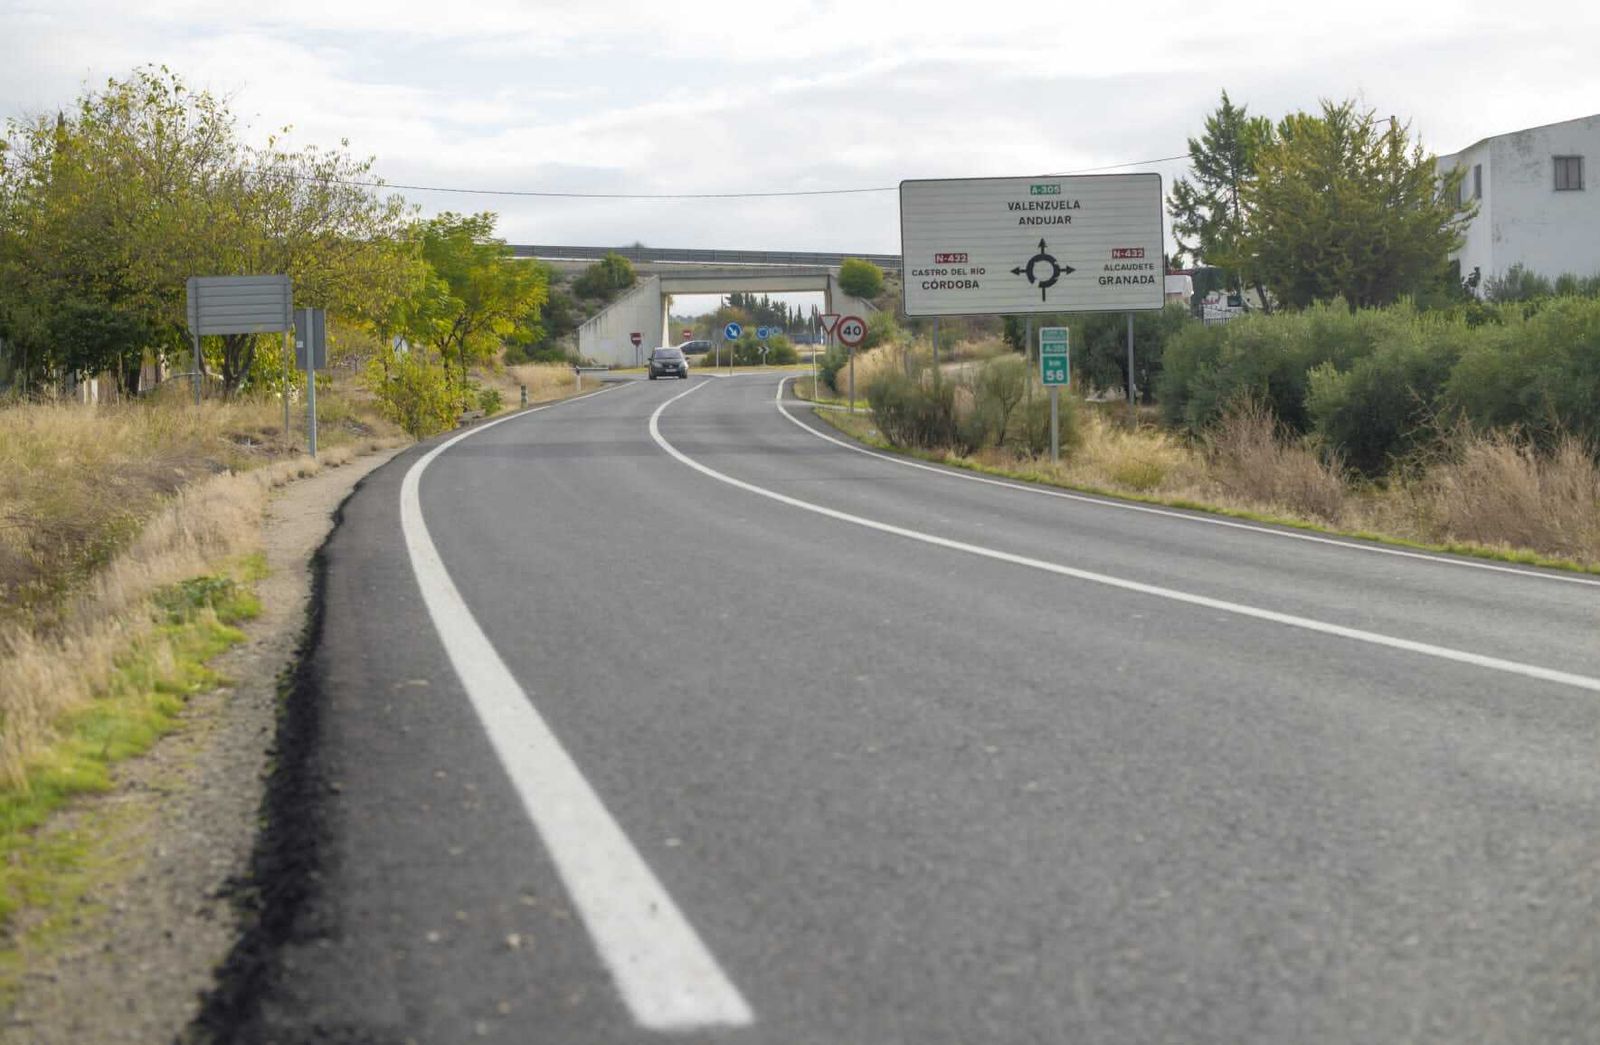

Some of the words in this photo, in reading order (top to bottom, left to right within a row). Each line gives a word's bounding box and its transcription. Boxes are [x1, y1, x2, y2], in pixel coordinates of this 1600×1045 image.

[1007, 200, 1081, 211] VALENZUELA
[1018, 215, 1072, 225] ANDUJAR
[911, 268, 948, 277] CASTRO
[951, 267, 967, 276] DEL
[1104, 263, 1154, 271] ALCAUDETE
[922, 278, 980, 290] CÓRDOBA
[1098, 275, 1155, 286] GRANADA
[843, 325, 862, 337] 40
[1046, 369, 1064, 381] 56
